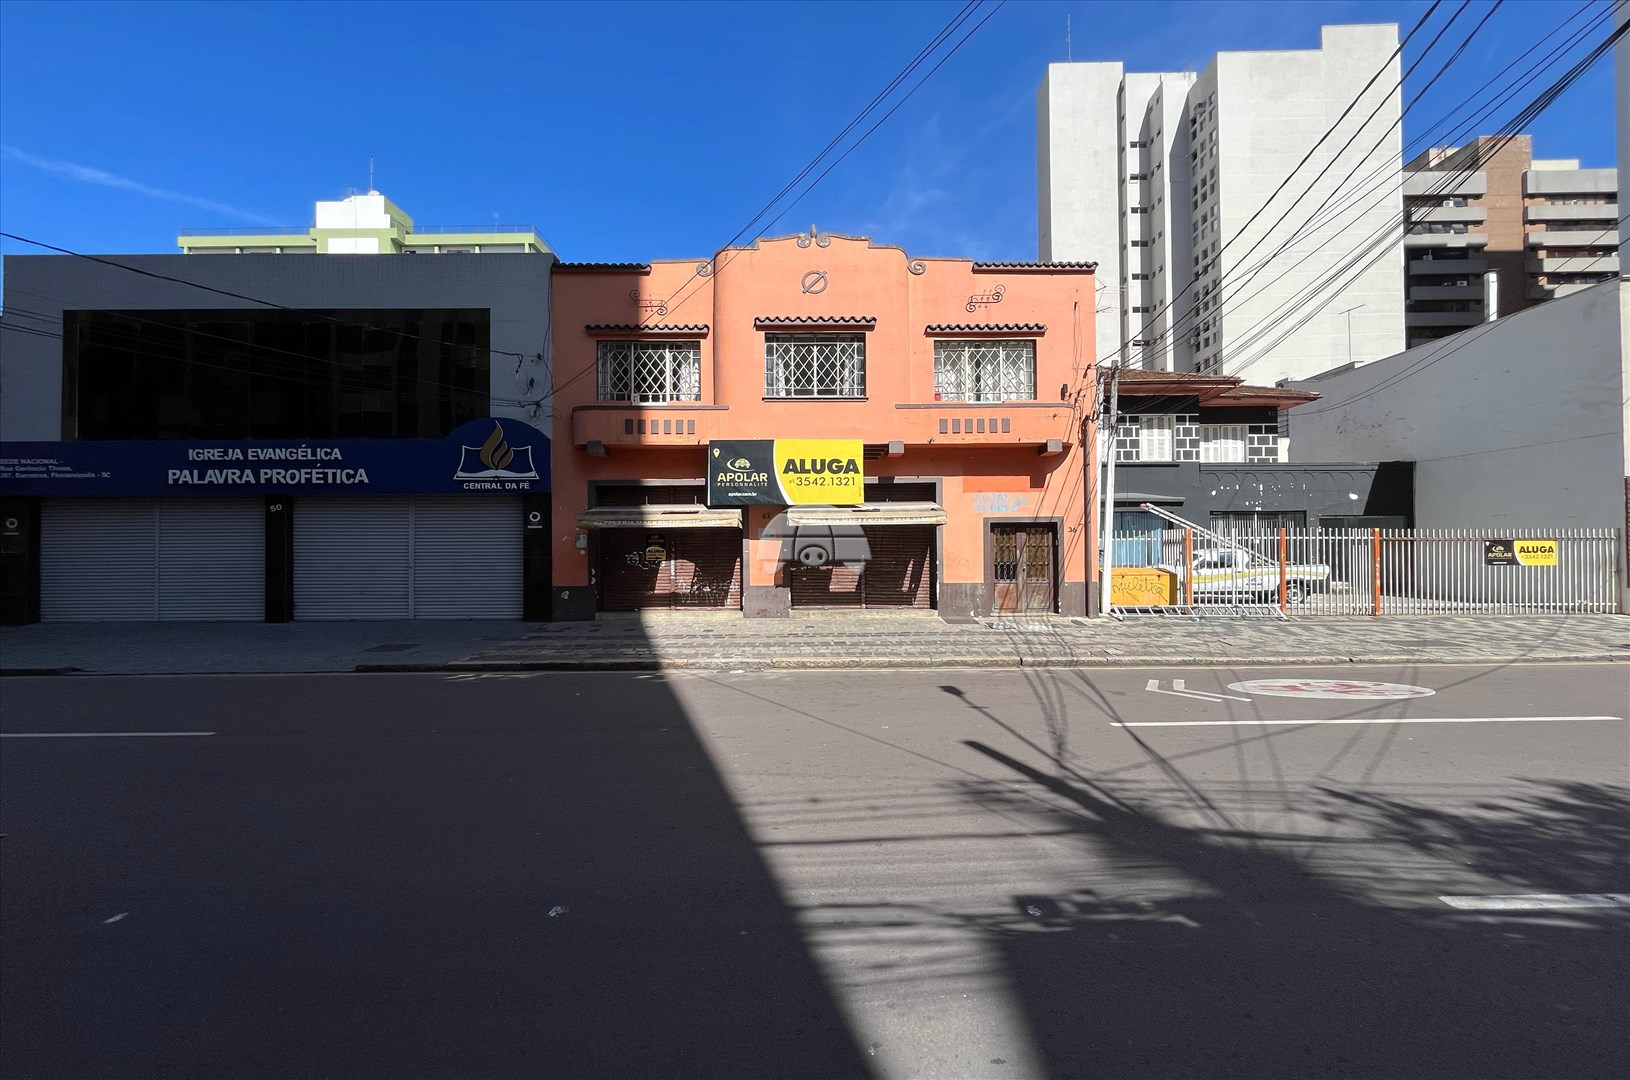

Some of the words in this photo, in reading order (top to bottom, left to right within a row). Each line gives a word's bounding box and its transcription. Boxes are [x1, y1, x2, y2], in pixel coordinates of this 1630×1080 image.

[188, 449, 244, 461] IGREJA
[247, 444, 342, 460] EVANGÉLICA
[783, 458, 860, 475] ALUGA
[168, 469, 256, 485] PALAVRA
[260, 464, 369, 484] PROFÉTICA
[717, 472, 768, 482] APOLAR
[463, 482, 503, 490] CENTRAL
[505, 482, 518, 490] DA
[519, 480, 531, 490] FÉ
[795, 476, 856, 486] 3542.1321
[269, 503, 283, 513] 50
[1518, 545, 1555, 554] ALUGA
